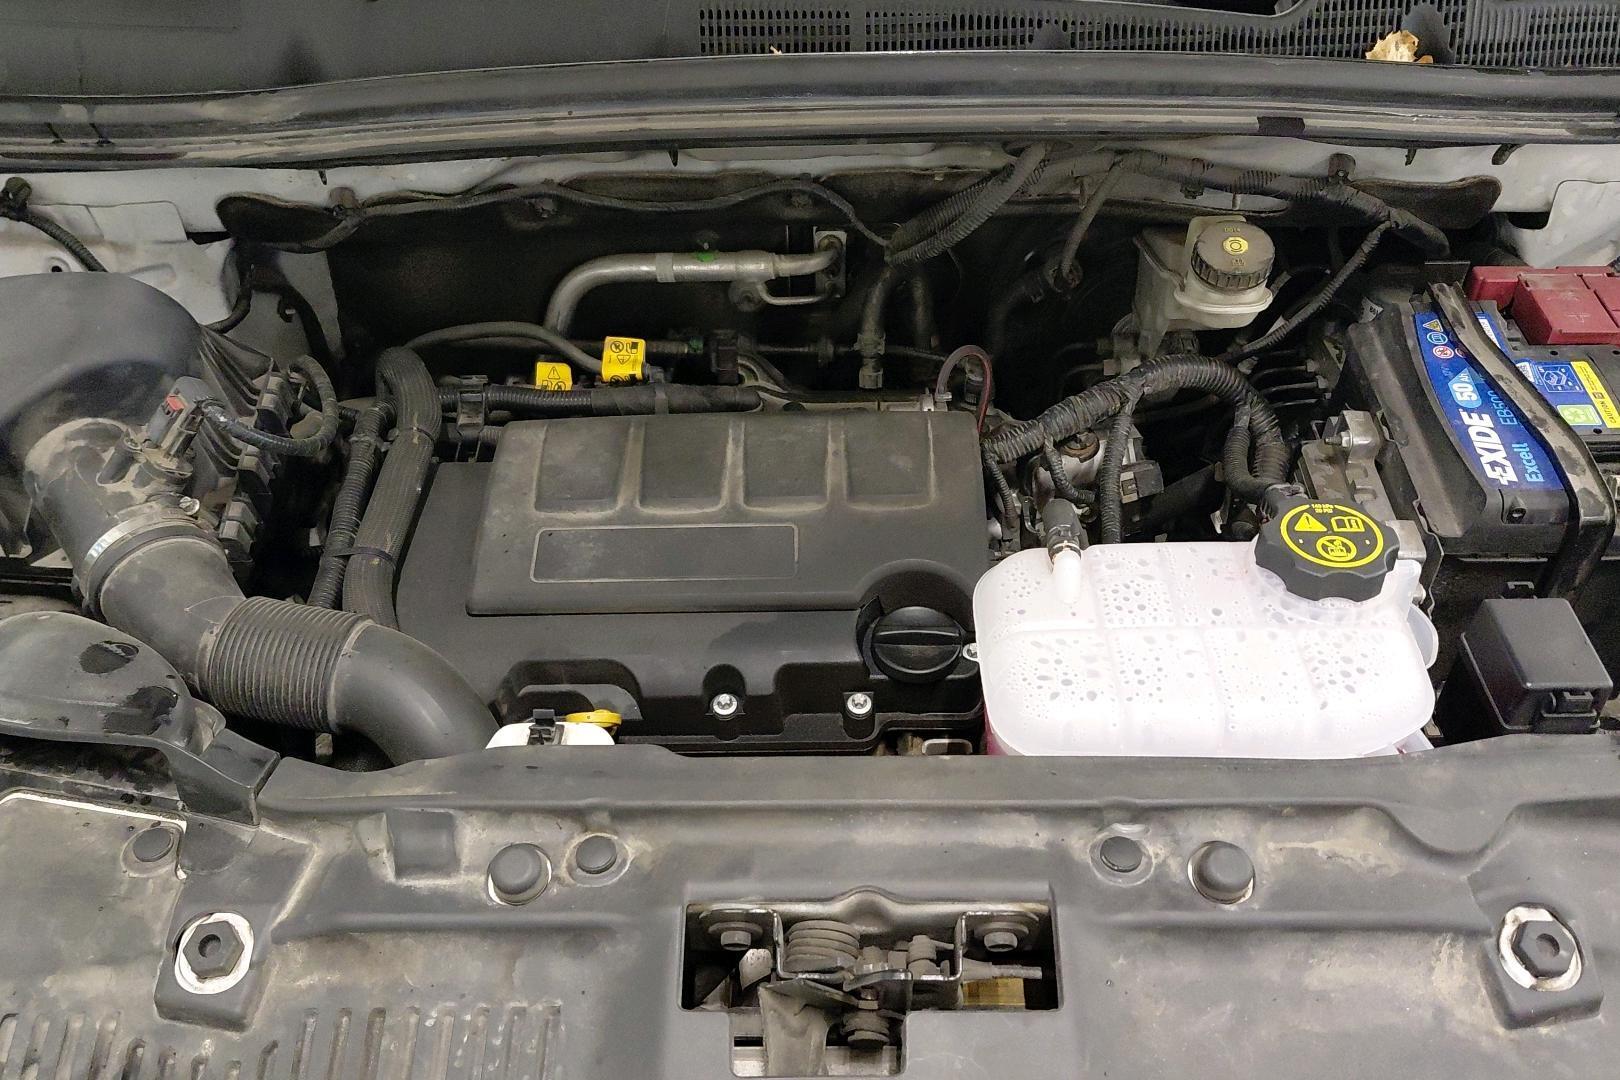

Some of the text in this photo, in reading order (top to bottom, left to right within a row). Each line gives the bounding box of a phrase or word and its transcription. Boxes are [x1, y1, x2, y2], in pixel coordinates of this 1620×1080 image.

[1452, 373, 1478, 401] 50 Ah
[1459, 411, 1519, 486] EXIDE
[1511, 442, 1545, 482] Excell
